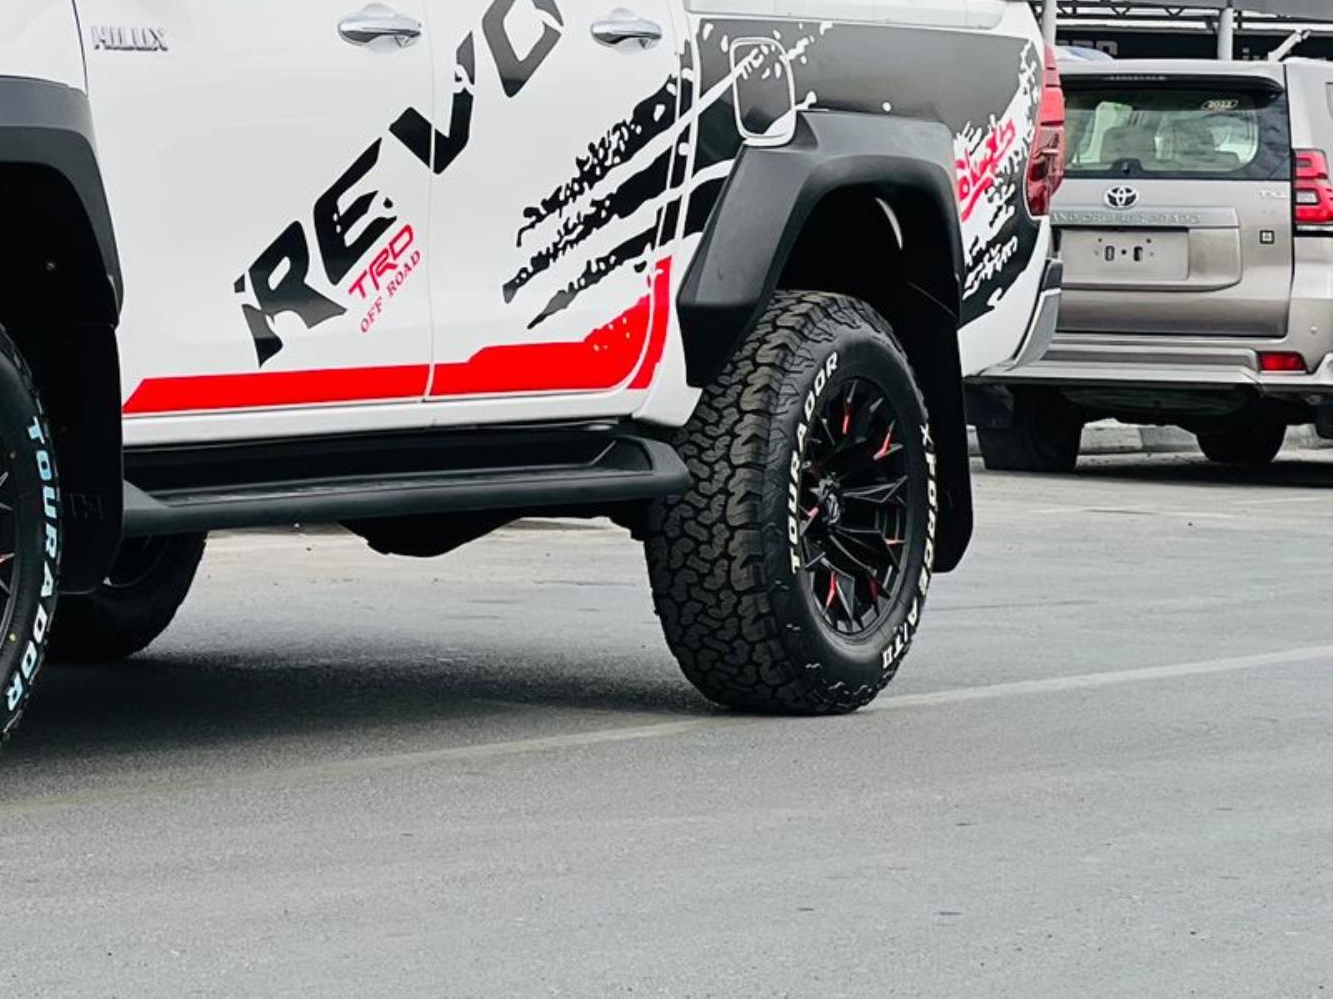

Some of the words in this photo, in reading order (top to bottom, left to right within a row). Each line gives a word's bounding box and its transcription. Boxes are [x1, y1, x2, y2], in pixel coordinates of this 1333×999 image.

[90, 25, 169, 52] HILUX
[348, 223, 414, 299] TRD
[359, 296, 383, 334] OFF
[386, 249, 422, 298] ROAD
[786, 350, 840, 575] TOURADOR
[7, 415, 58, 712] TOURADOR
